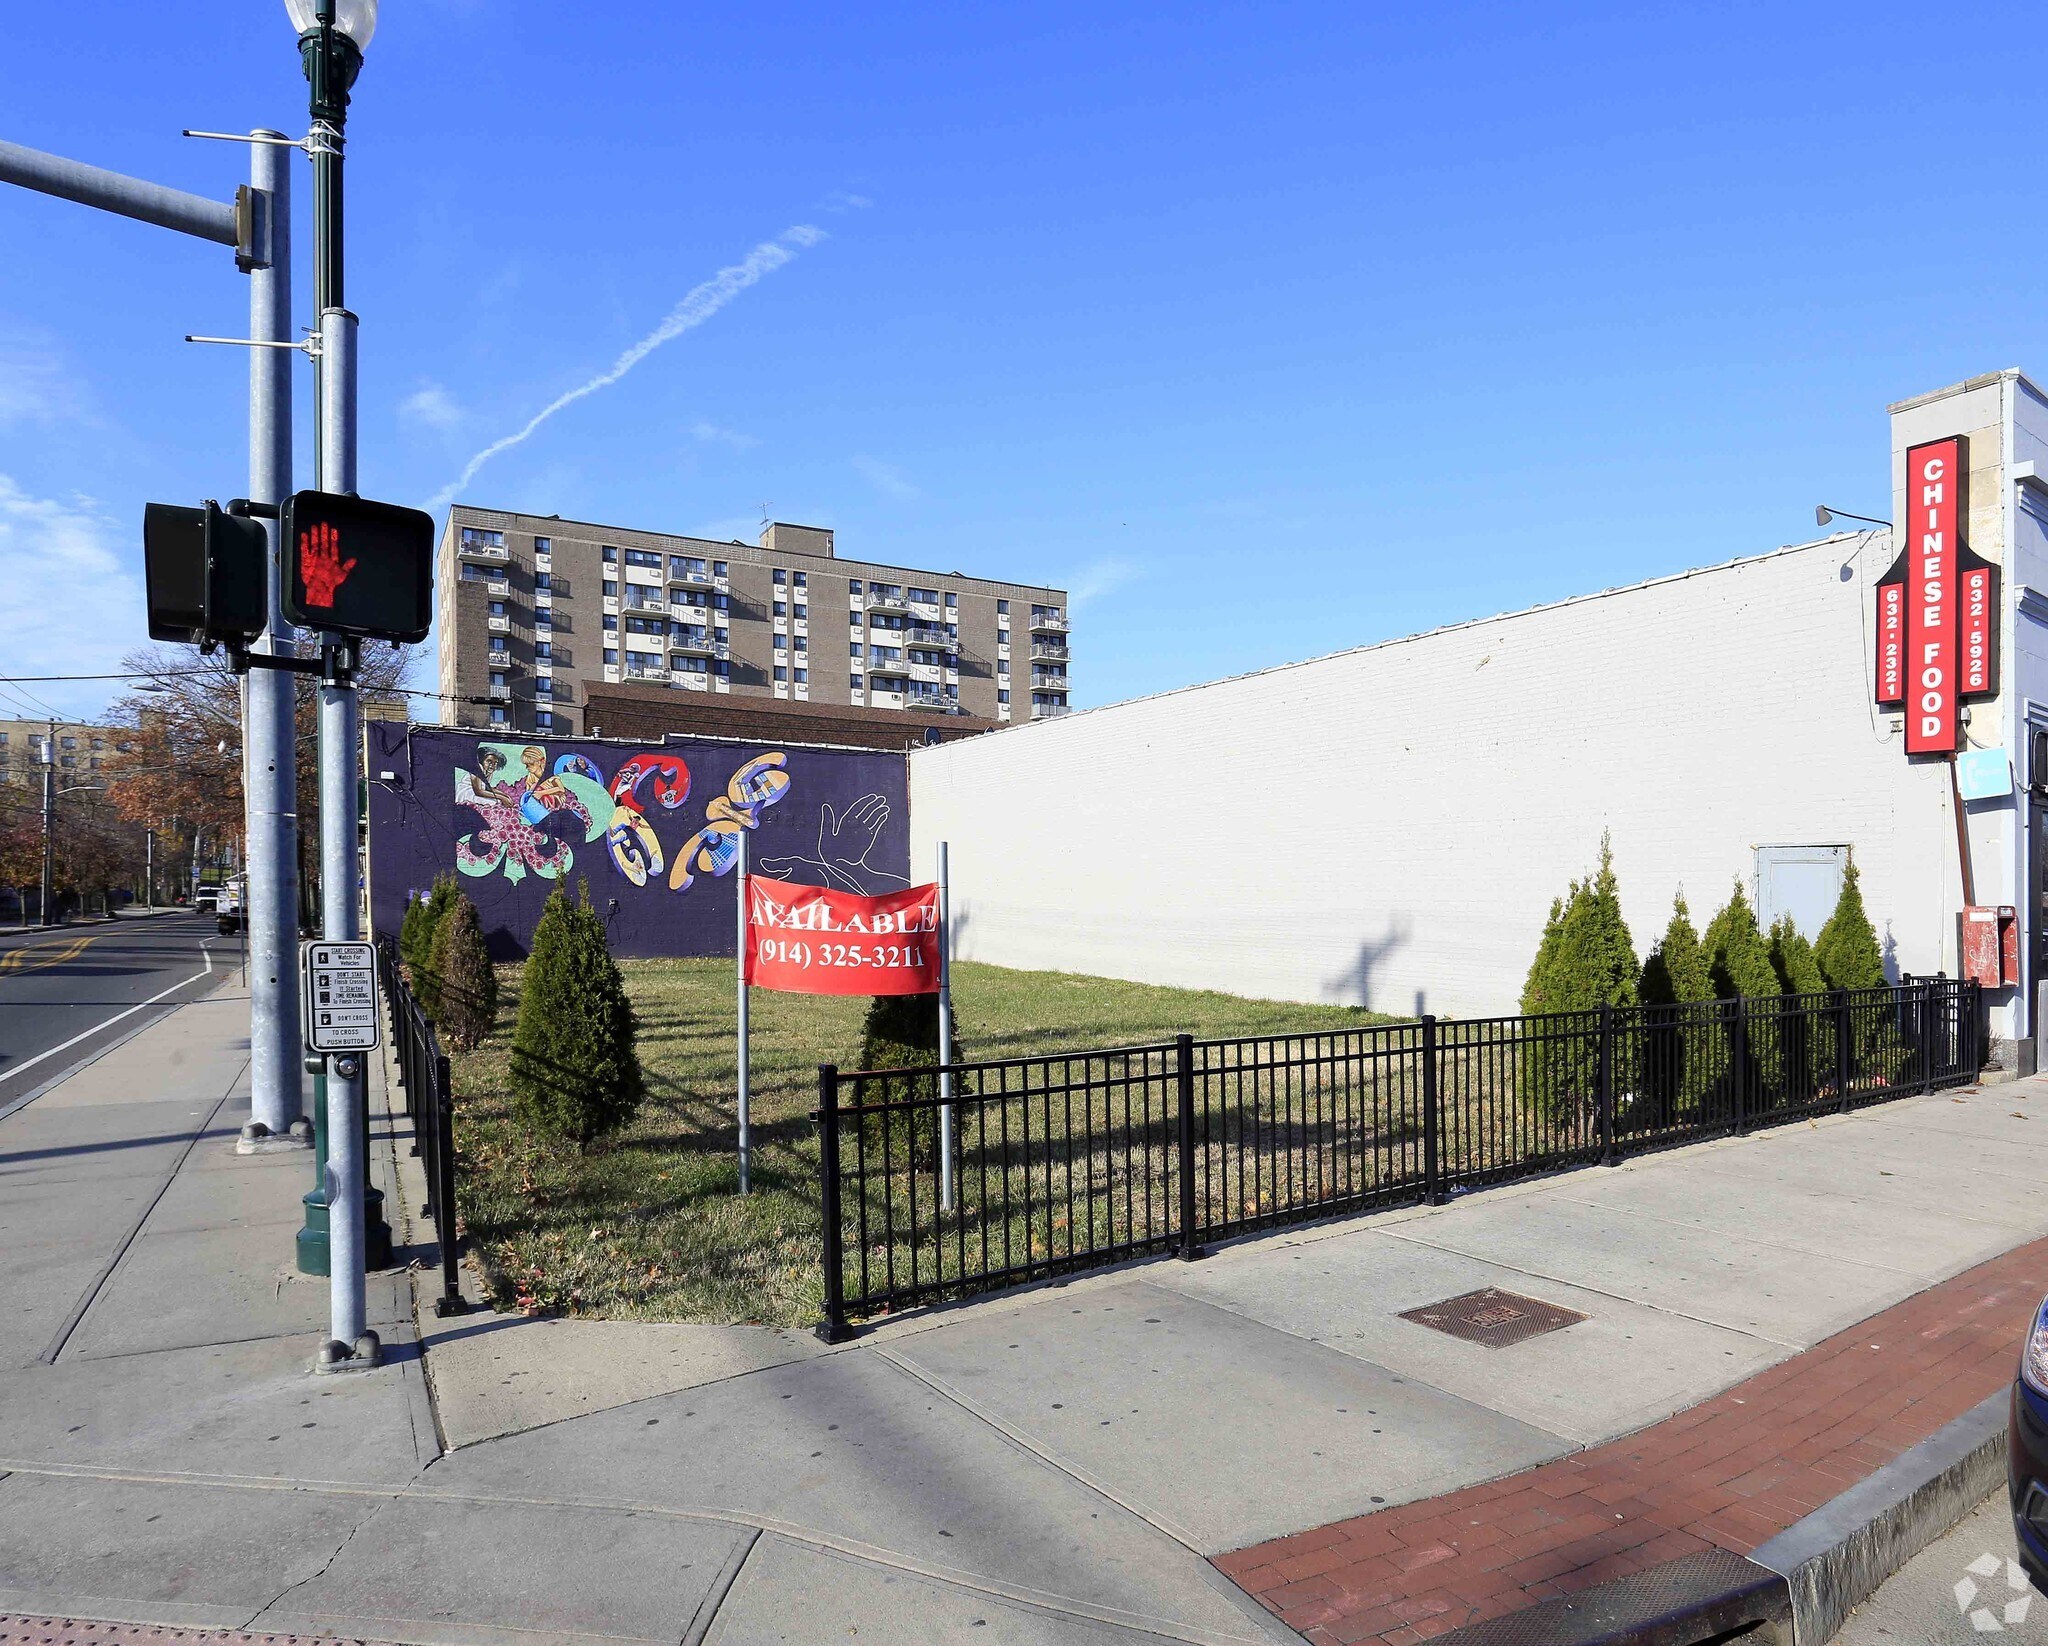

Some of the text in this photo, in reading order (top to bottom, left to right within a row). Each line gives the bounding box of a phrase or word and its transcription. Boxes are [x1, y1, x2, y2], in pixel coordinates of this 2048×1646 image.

[1921, 458, 1944, 738] CHINESE FOOD
[749, 898, 936, 934] AVAILABLE
[759, 938, 925, 969] (914) 325-3211
